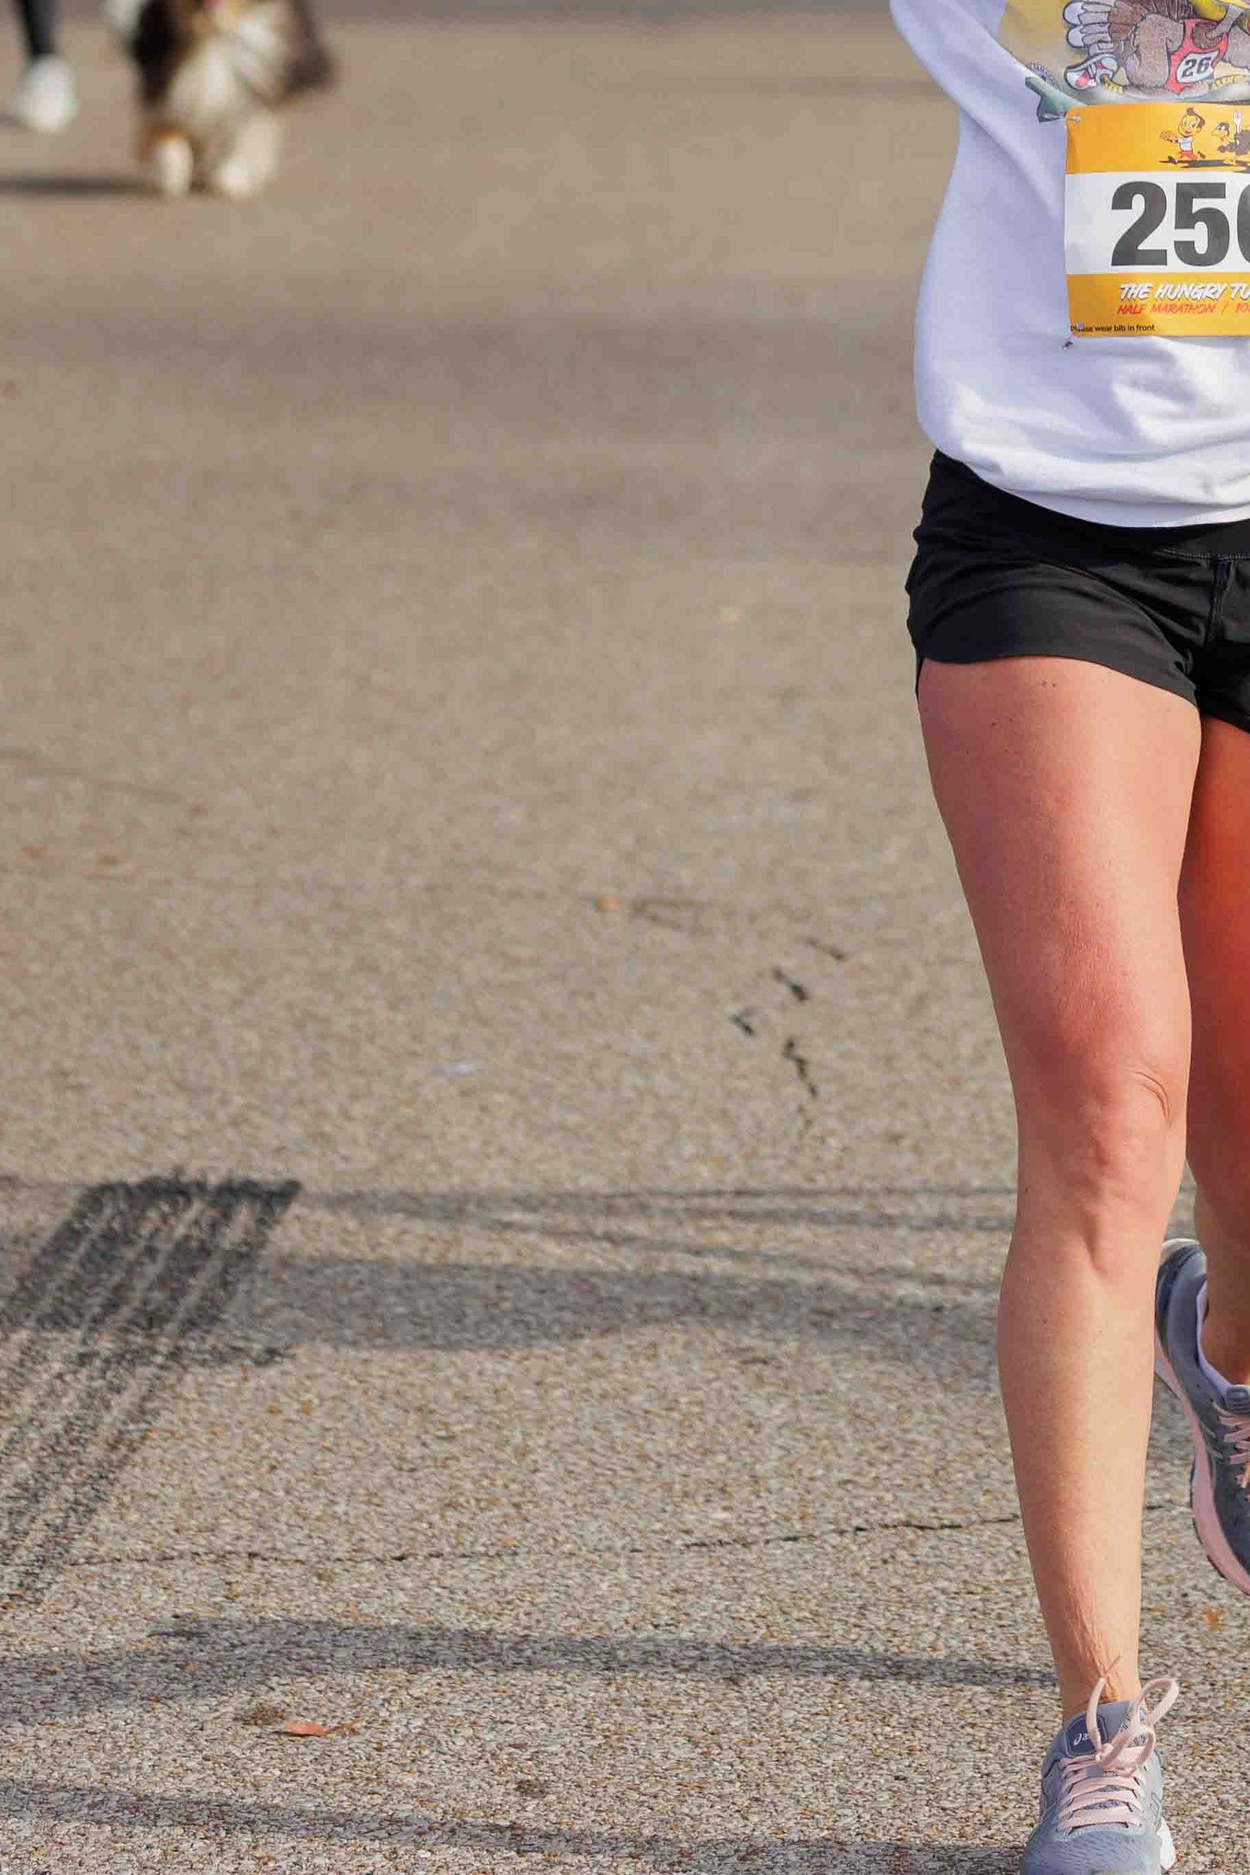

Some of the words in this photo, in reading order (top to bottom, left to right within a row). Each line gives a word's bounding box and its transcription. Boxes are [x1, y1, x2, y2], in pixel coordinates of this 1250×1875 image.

[1182, 56, 1212, 78] 26
[1119, 283, 1152, 301] THE
[1155, 283, 1227, 301] HUNGRY
[1117, 303, 1146, 315] HALF
[1151, 303, 1217, 314] MARATHON
[1114, 324, 1126, 332] bib
[1136, 324, 1155, 332] front
